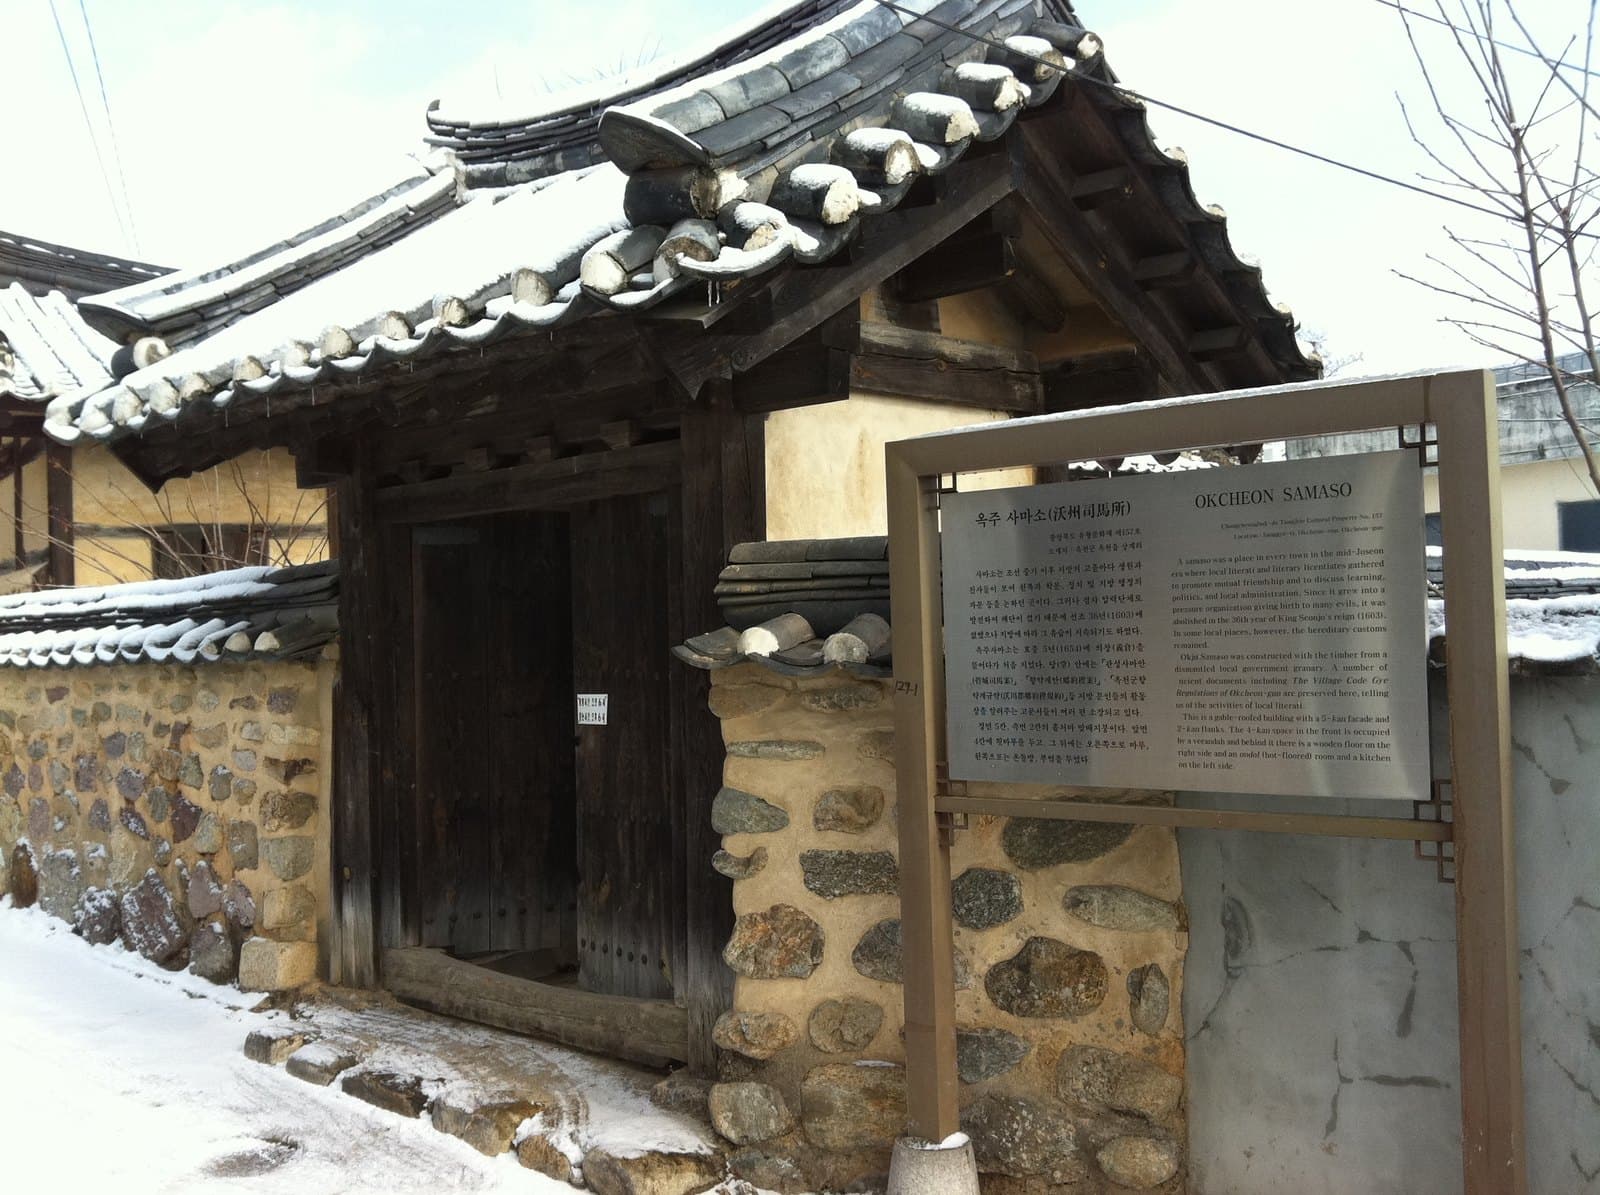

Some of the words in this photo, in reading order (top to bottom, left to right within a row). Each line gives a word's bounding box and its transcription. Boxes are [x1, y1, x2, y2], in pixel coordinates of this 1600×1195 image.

[1194, 488, 1274, 508] OKCHEON
[1282, 482, 1352, 501] SAMASO
[975, 510, 1000, 528] 옥주
[1006, 497, 1130, 525] 사마소(沃州司馬所)
[1233, 553, 1252, 563] place
[1265, 552, 1285, 561] every
[1288, 550, 1308, 559] town
[1320, 549, 1333, 557] the
[1335, 546, 1384, 556] mid-Joseon
[1184, 568, 1205, 576] where
[1208, 566, 1226, 575] local
[1228, 565, 1254, 574] literati
[1256, 564, 1270, 573] and
[1272, 563, 1300, 574] literary
[1303, 561, 1346, 571] licentiates
[1347, 559, 1384, 570] gathered
[1181, 579, 1210, 590] promote
[1214, 578, 1240, 587] mutual
[1242, 576, 1284, 587] friendship
[1286, 576, 1300, 584] and
[1314, 574, 1344, 583] discuss
[1346, 572, 1384, 583] learning,
[1171, 592, 1202, 602] politics,
[1204, 591, 1218, 599] and
[1220, 590, 1238, 599] local
[1303, 587, 1325, 596] Since
[1337, 587, 1356, 596] grew
[1360, 585, 1378, 594] into
[1172, 605, 1202, 614] pressure
[1205, 602, 1252, 613] organization
[1253, 602, 1278, 612] giving
[1279, 601, 1299, 609] birth
[1312, 601, 1332, 610] many
[1335, 599, 1358, 609] evils,
[1172, 616, 1206, 624] abolished
[1217, 615, 1228, 623] the
[1232, 615, 1248, 623] 36th
[1250, 616, 1265, 624] year
[1278, 614, 1297, 623] King
[1333, 612, 1354, 622] reign
[1357, 611, 1387, 621] (1603).
[1224, 627, 1251, 636] places,
[1253, 626, 1290, 636] however,
[1291, 626, 1303, 634] the
[1307, 625, 1349, 635] hereditary
[1352, 624, 1386, 632] customs
[1246, 651, 1292, 659] constructed
[1314, 650, 1327, 658] the
[1330, 650, 1357, 658] timber
[1360, 650, 1380, 658] from
[1174, 664, 1215, 672] dismantled
[1219, 664, 1237, 672] local
[1242, 664, 1288, 673] government
[1342, 663, 1373, 671] number
[1205, 676, 1246, 684] documents
[1250, 676, 1287, 686] including
[1293, 676, 1307, 684] The
[1313, 676, 1341, 686] Village
[1346, 676, 1366, 684] Code
[1176, 688, 1218, 697] Regulations
[1229, 688, 1281, 698] Okcheon-gun
[1297, 689, 1336, 698] preserved
[1338, 689, 1359, 698] here,
[1361, 689, 1388, 698] telling
[1194, 700, 1204, 708] the
[1254, 701, 1272, 709] local
[1183, 712, 1198, 720] This
[1214, 712, 1262, 722] gable-roofed
[1262, 713, 1293, 722] building
[1295, 713, 1313, 721] with
[1321, 714, 1346, 722] 5-kan
[1347, 714, 1372, 722] facade
[1375, 714, 1389, 722] and
[1272, 727, 1291, 735] space
[1305, 726, 1317, 734] the
[1321, 726, 1340, 734] front
[1353, 727, 1390, 737] occupied
[1193, 736, 1225, 744] verandah
[1227, 737, 1239, 745] and
[1240, 737, 1266, 745] behind
[1275, 738, 1295, 746] there
[1313, 739, 1342, 747] wooden
[1344, 739, 1362, 748] floor
[1376, 740, 1391, 748] the
[1177, 748, 1194, 757] right
[1197, 748, 1211, 756] side
[1239, 749, 1260, 758] ondol
[1261, 750, 1312, 761] (hot-floored)
[1336, 752, 1350, 760] and
[1359, 753, 1390, 761] kitchen
[1188, 760, 1200, 768] the
[1202, 760, 1215, 768] left
